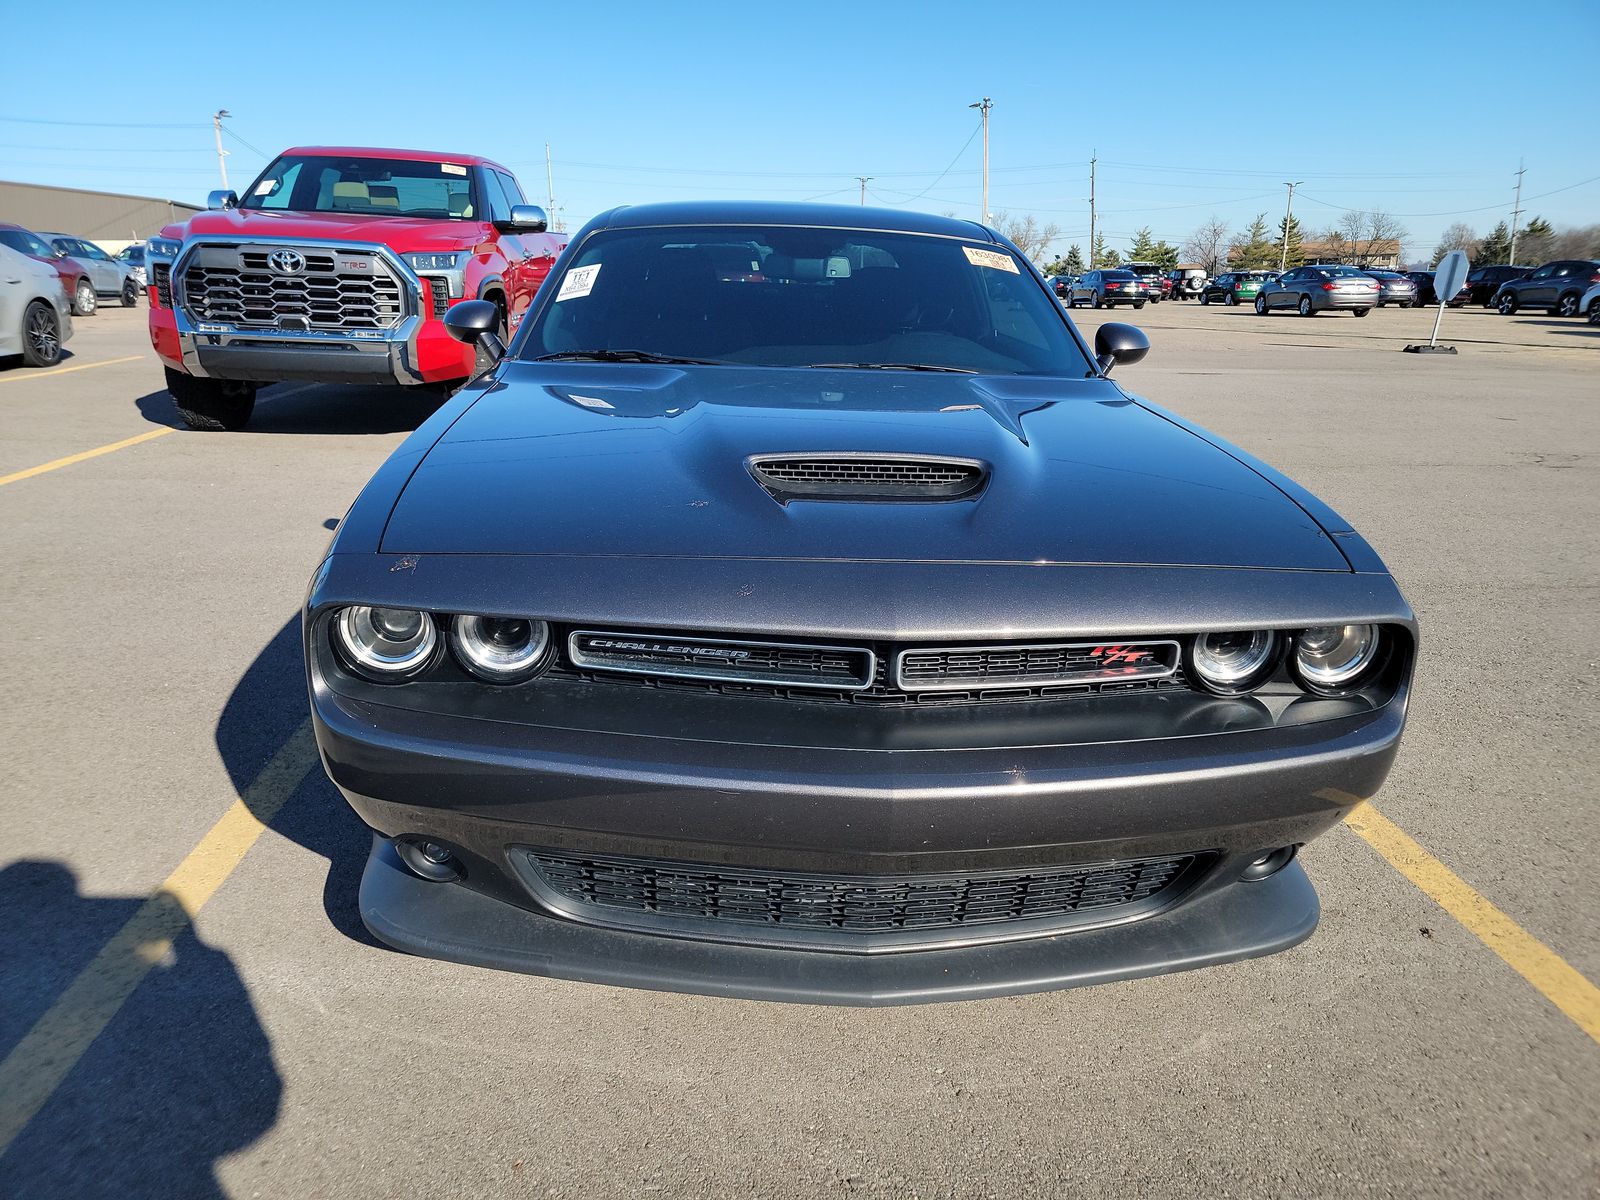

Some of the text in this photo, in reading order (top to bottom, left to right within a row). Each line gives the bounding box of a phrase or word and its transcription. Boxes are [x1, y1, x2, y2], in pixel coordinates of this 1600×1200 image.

[341, 261, 367, 269] TRD
[589, 639, 750, 658] CHALLENGER
[1090, 645, 1151, 666] R/T
